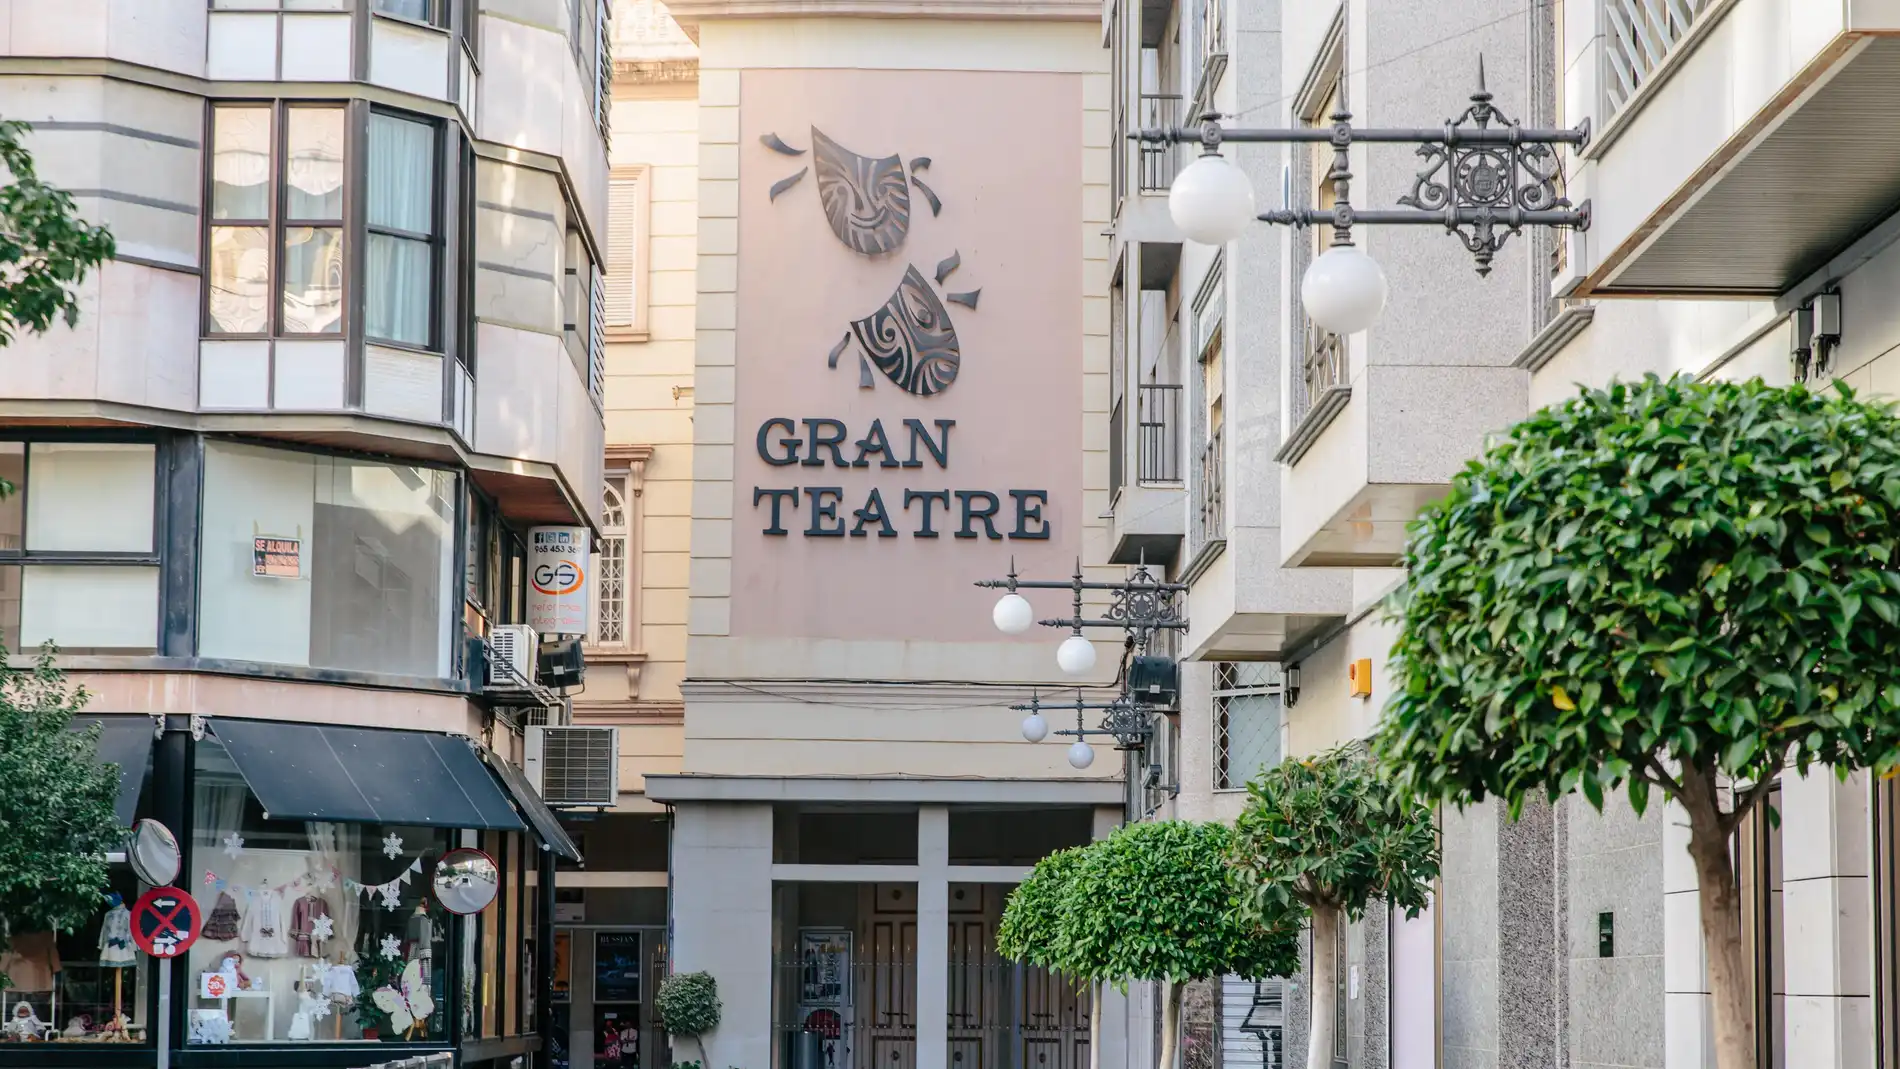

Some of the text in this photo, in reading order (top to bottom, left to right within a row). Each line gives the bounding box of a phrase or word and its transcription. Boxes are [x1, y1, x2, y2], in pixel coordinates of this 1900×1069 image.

[756, 418, 956, 468] GRAN
[753, 486, 1050, 539] TEATRE
[255, 540, 299, 553] SE ALQUILA
[534, 545, 548, 553] 965
[550, 545, 565, 553] 453
